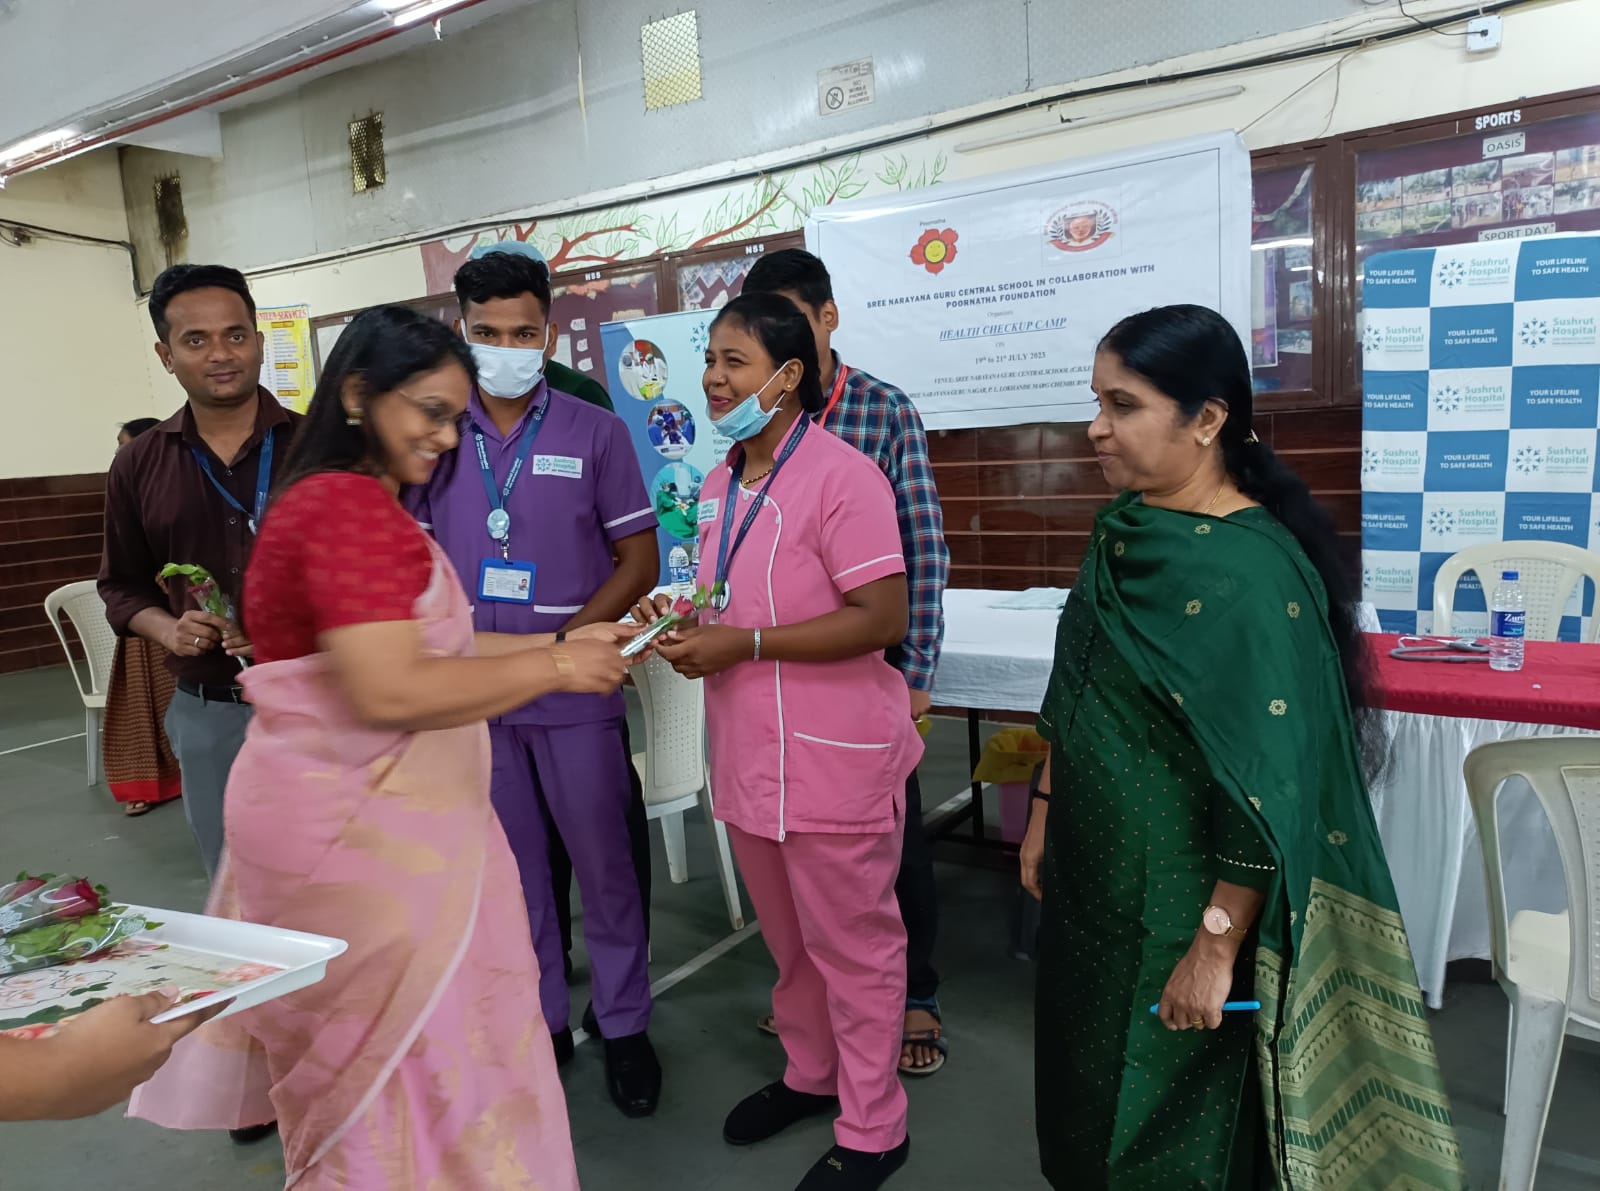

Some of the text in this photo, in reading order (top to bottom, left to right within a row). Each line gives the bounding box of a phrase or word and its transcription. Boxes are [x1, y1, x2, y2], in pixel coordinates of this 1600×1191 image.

[1475, 109, 1521, 130] SPORTS
[1487, 138, 1521, 153] OASIS
[1484, 225, 1550, 241] SPORT DAY
[746, 244, 765, 255] NSS
[1471, 258, 1509, 267] Sushrut
[1554, 257, 1587, 265] LIFELINE
[1369, 269, 1386, 277] YOUR
[1469, 265, 1511, 276] Hospital
[1532, 266, 1589, 276] TO SAFE HEALTH
[584, 272, 601, 281] NSS
[1375, 277, 1391, 285] SAFE
[1392, 277, 1417, 285] HEALTH
[867, 264, 1156, 309] SREE NARAYANA GURU CENTRAL SCHOOL IN COLLABORATION WITH
[946, 288, 1056, 309] POORNATHA FOUNDATION
[1553, 317, 1594, 326] Sushrut
[939, 317, 1068, 341] HEALTH CHECKUP CAMP
[1385, 326, 1423, 335] Sushrut
[1447, 328, 1496, 337] YOUR LIFELINE
[1552, 325, 1597, 337] Hospital
[1384, 333, 1425, 344] Hospital
[1444, 336, 1498, 345] TO SAFE HEALTH
[1008, 353, 1028, 362] JULY
[1030, 351, 1046, 360] 2023
[1464, 386, 1503, 395] Sushrut
[1529, 389, 1546, 397] YOUR
[1384, 393, 1411, 401] LIFELINE
[1464, 393, 1505, 404] Hospital
[1536, 397, 1553, 405] SAFE
[1554, 397, 1583, 405] HEALTH
[1373, 401, 1389, 409] SAFE
[1389, 401, 1414, 409] HEALTH
[1383, 449, 1419, 457] Sushrut
[1546, 446, 1587, 456] Sushrut
[1382, 456, 1421, 466] Hospital
[1462, 453, 1491, 461] LIFELINE
[1545, 454, 1590, 465] Hospital
[1449, 461, 1466, 469] SAFE
[1467, 461, 1493, 469] HEALTH
[1458, 509, 1496, 518] Sushrut
[1457, 516, 1498, 528] Hospital
[1529, 523, 1546, 531] SAFE
[1547, 523, 1574, 531] HEALTH
[1375, 567, 1412, 576] Sushrut
[1375, 575, 1414, 585] Hospital
